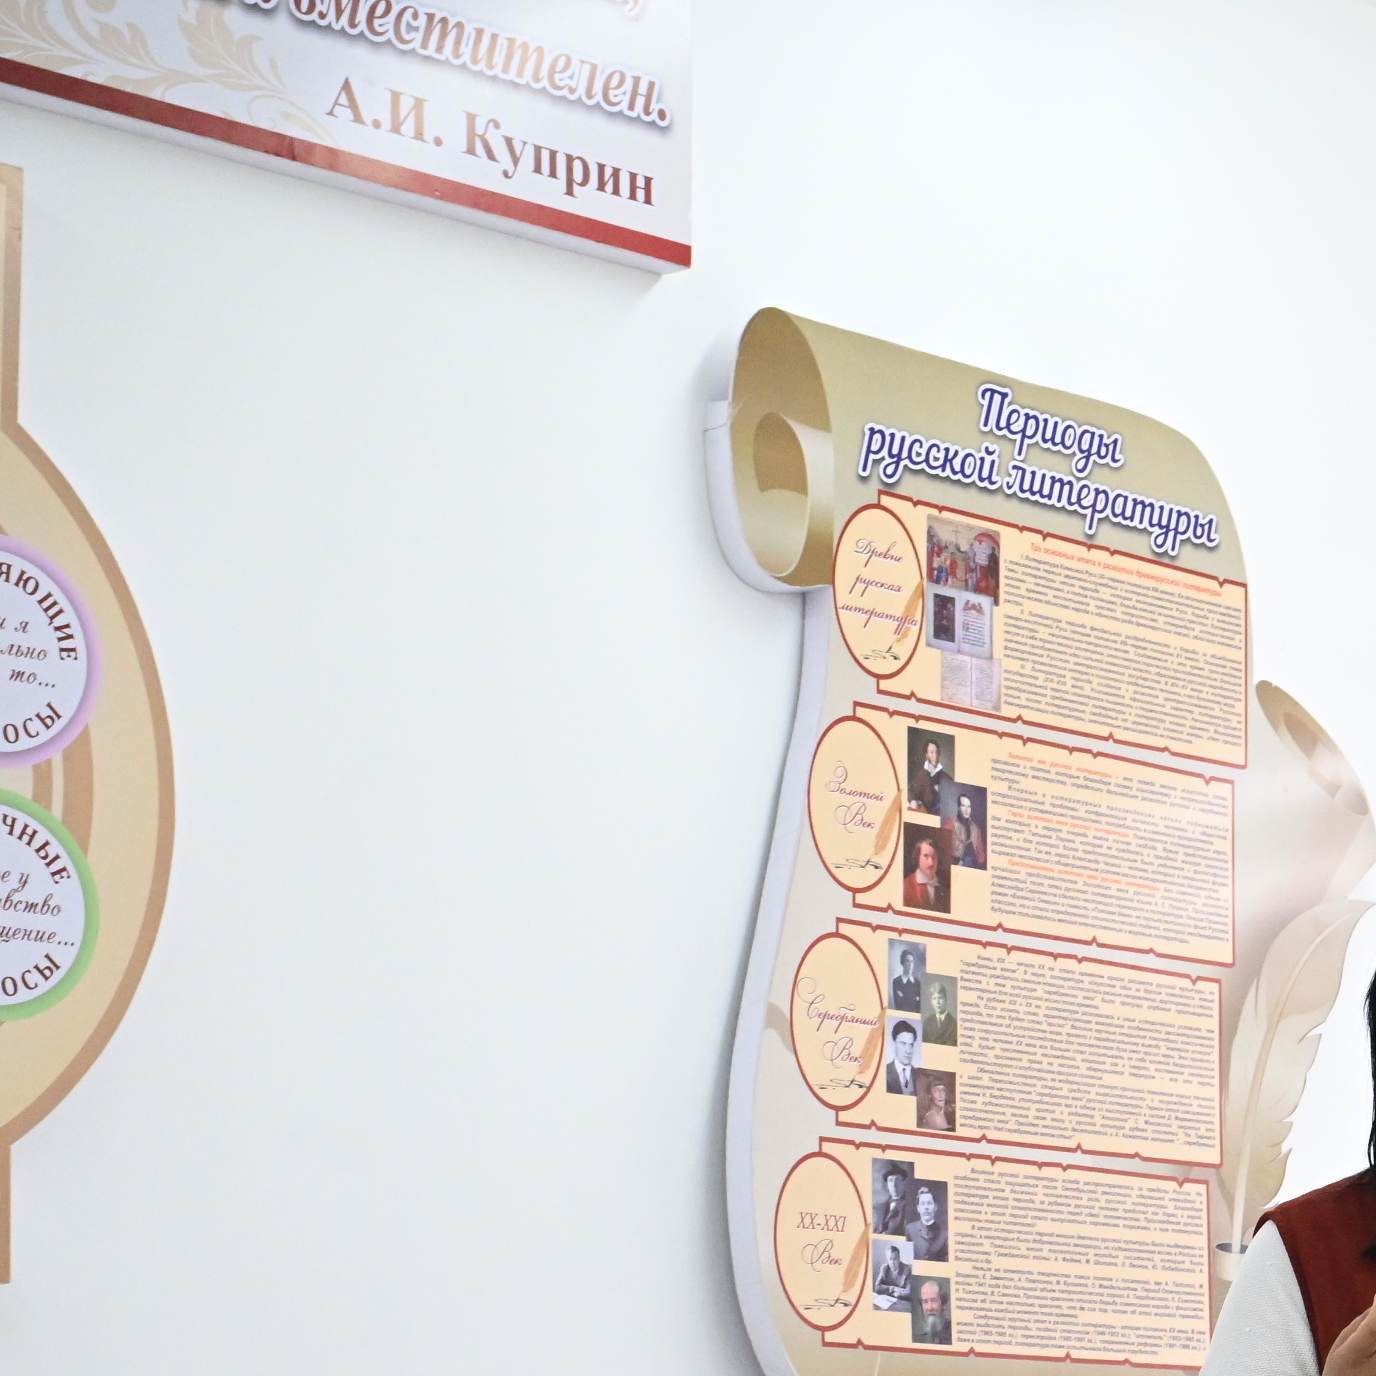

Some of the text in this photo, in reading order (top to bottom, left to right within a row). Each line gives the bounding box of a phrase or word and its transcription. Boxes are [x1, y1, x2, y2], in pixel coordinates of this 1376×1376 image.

[327, 76, 655, 207] А.И. Куприн
[980, 387, 1121, 472] Периоды
[861, 427, 1217, 551] русской литературы
[854, 539, 903, 568] Древне
[849, 574, 902, 597] русская
[825, 760, 884, 802] Золотой
[834, 802, 875, 834] Век
[797, 977, 879, 1034] Серебряный
[822, 1036, 862, 1069] Век
[801, 1239, 842, 1272] Век
